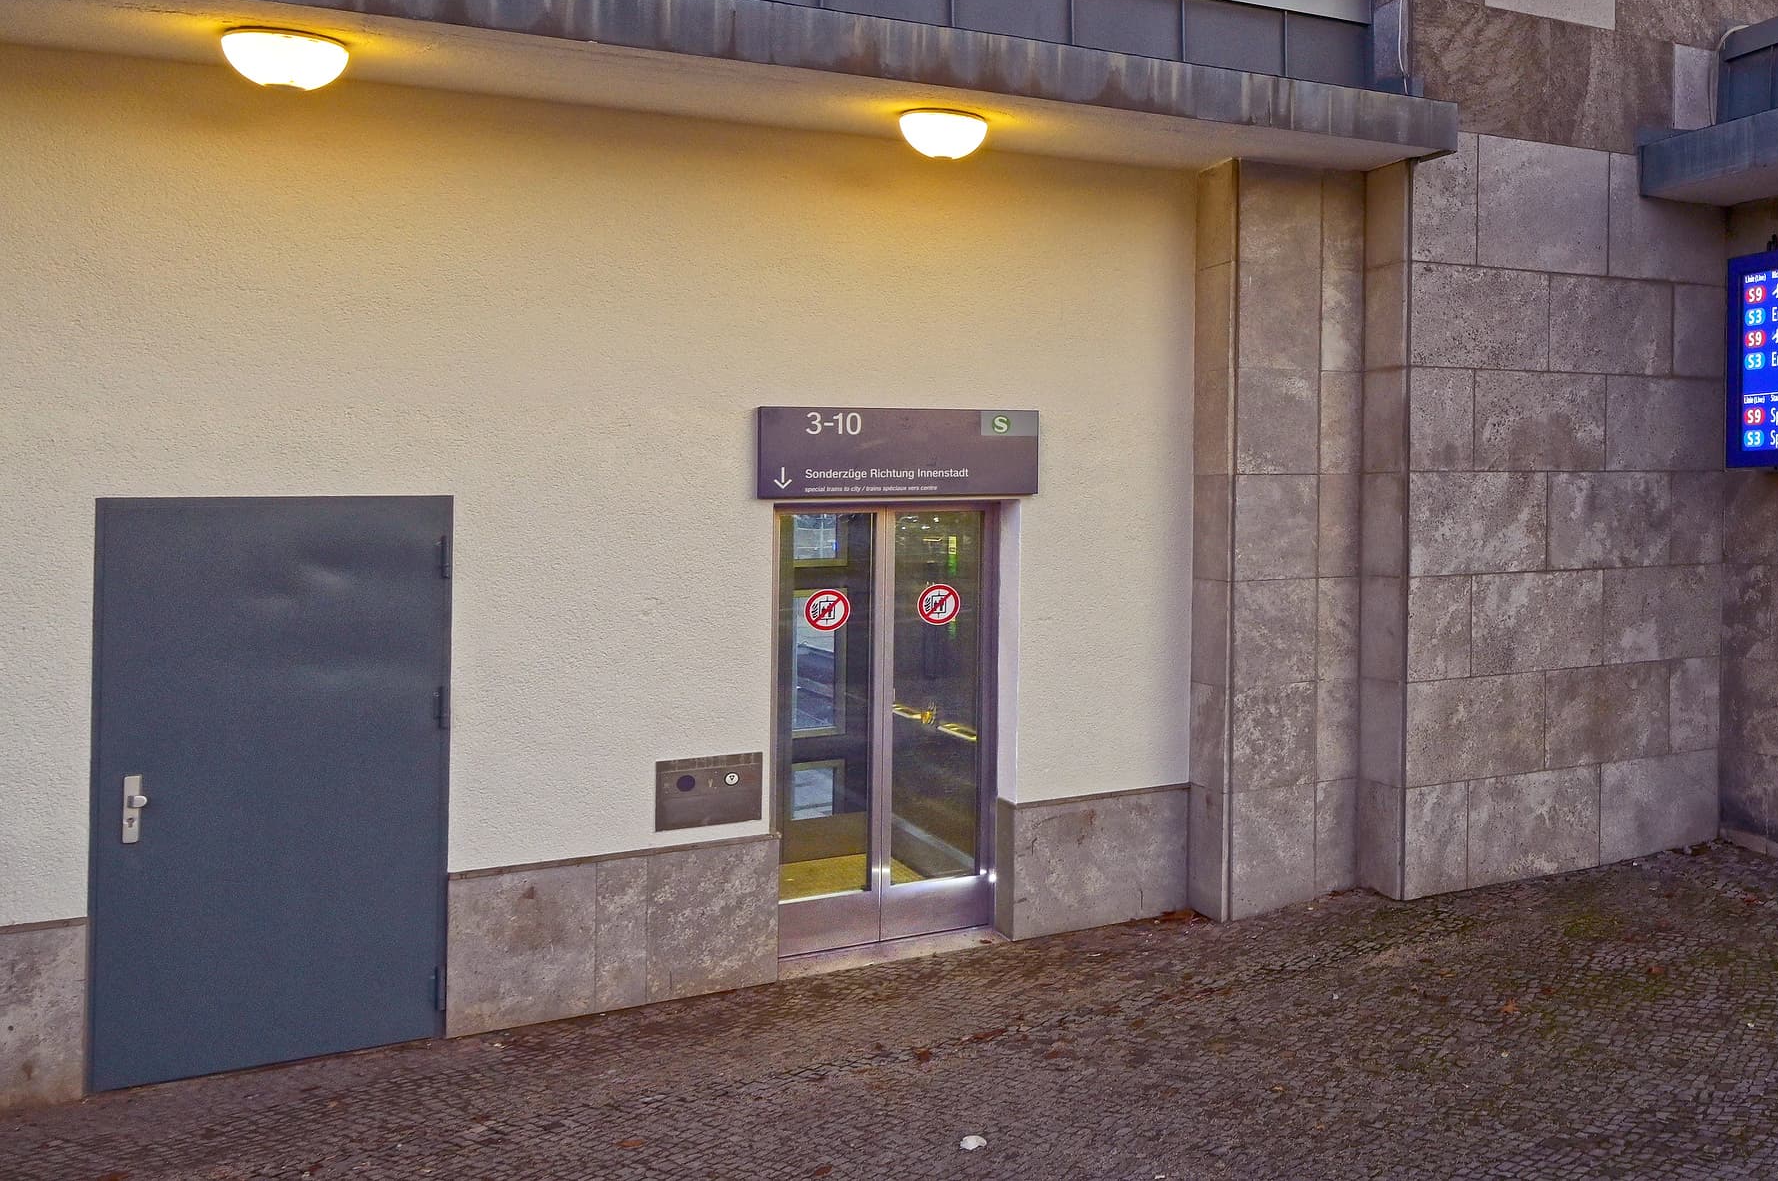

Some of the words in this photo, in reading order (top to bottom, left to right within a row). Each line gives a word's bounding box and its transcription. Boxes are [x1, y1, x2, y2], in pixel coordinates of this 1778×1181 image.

[1748, 286, 1763, 303] S9
[1748, 309, 1763, 325] S3
[1748, 331, 1763, 347] S9
[1747, 353, 1762, 369] S3
[805, 411, 863, 436] 3-10
[1747, 408, 1762, 424] S9
[992, 416, 1010, 434] S
[1747, 431, 1761, 446] S3
[805, 468, 868, 481] Sonderzüge
[870, 468, 915, 480] Richtung
[917, 467, 969, 479] Innenstadt
[804, 485, 826, 493] special
[850, 485, 861, 493] city
